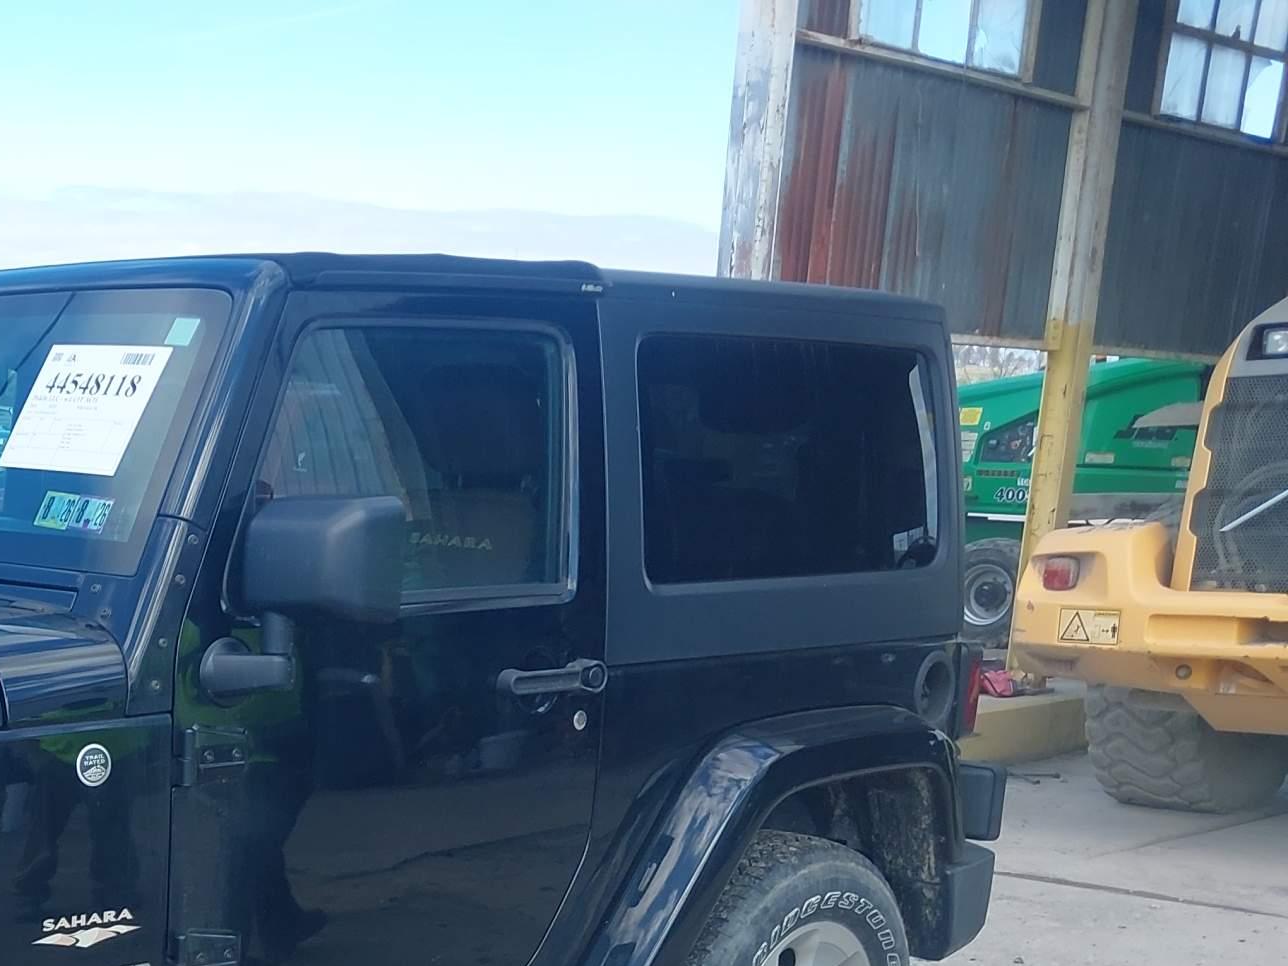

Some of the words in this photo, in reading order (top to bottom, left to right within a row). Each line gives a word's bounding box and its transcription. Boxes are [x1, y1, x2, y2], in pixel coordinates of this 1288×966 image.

[45, 372, 142, 398] 44548118
[83, 758, 106, 767] RATED
[84, 753, 105, 761] TRAIL
[42, 908, 133, 932] SAHARA
